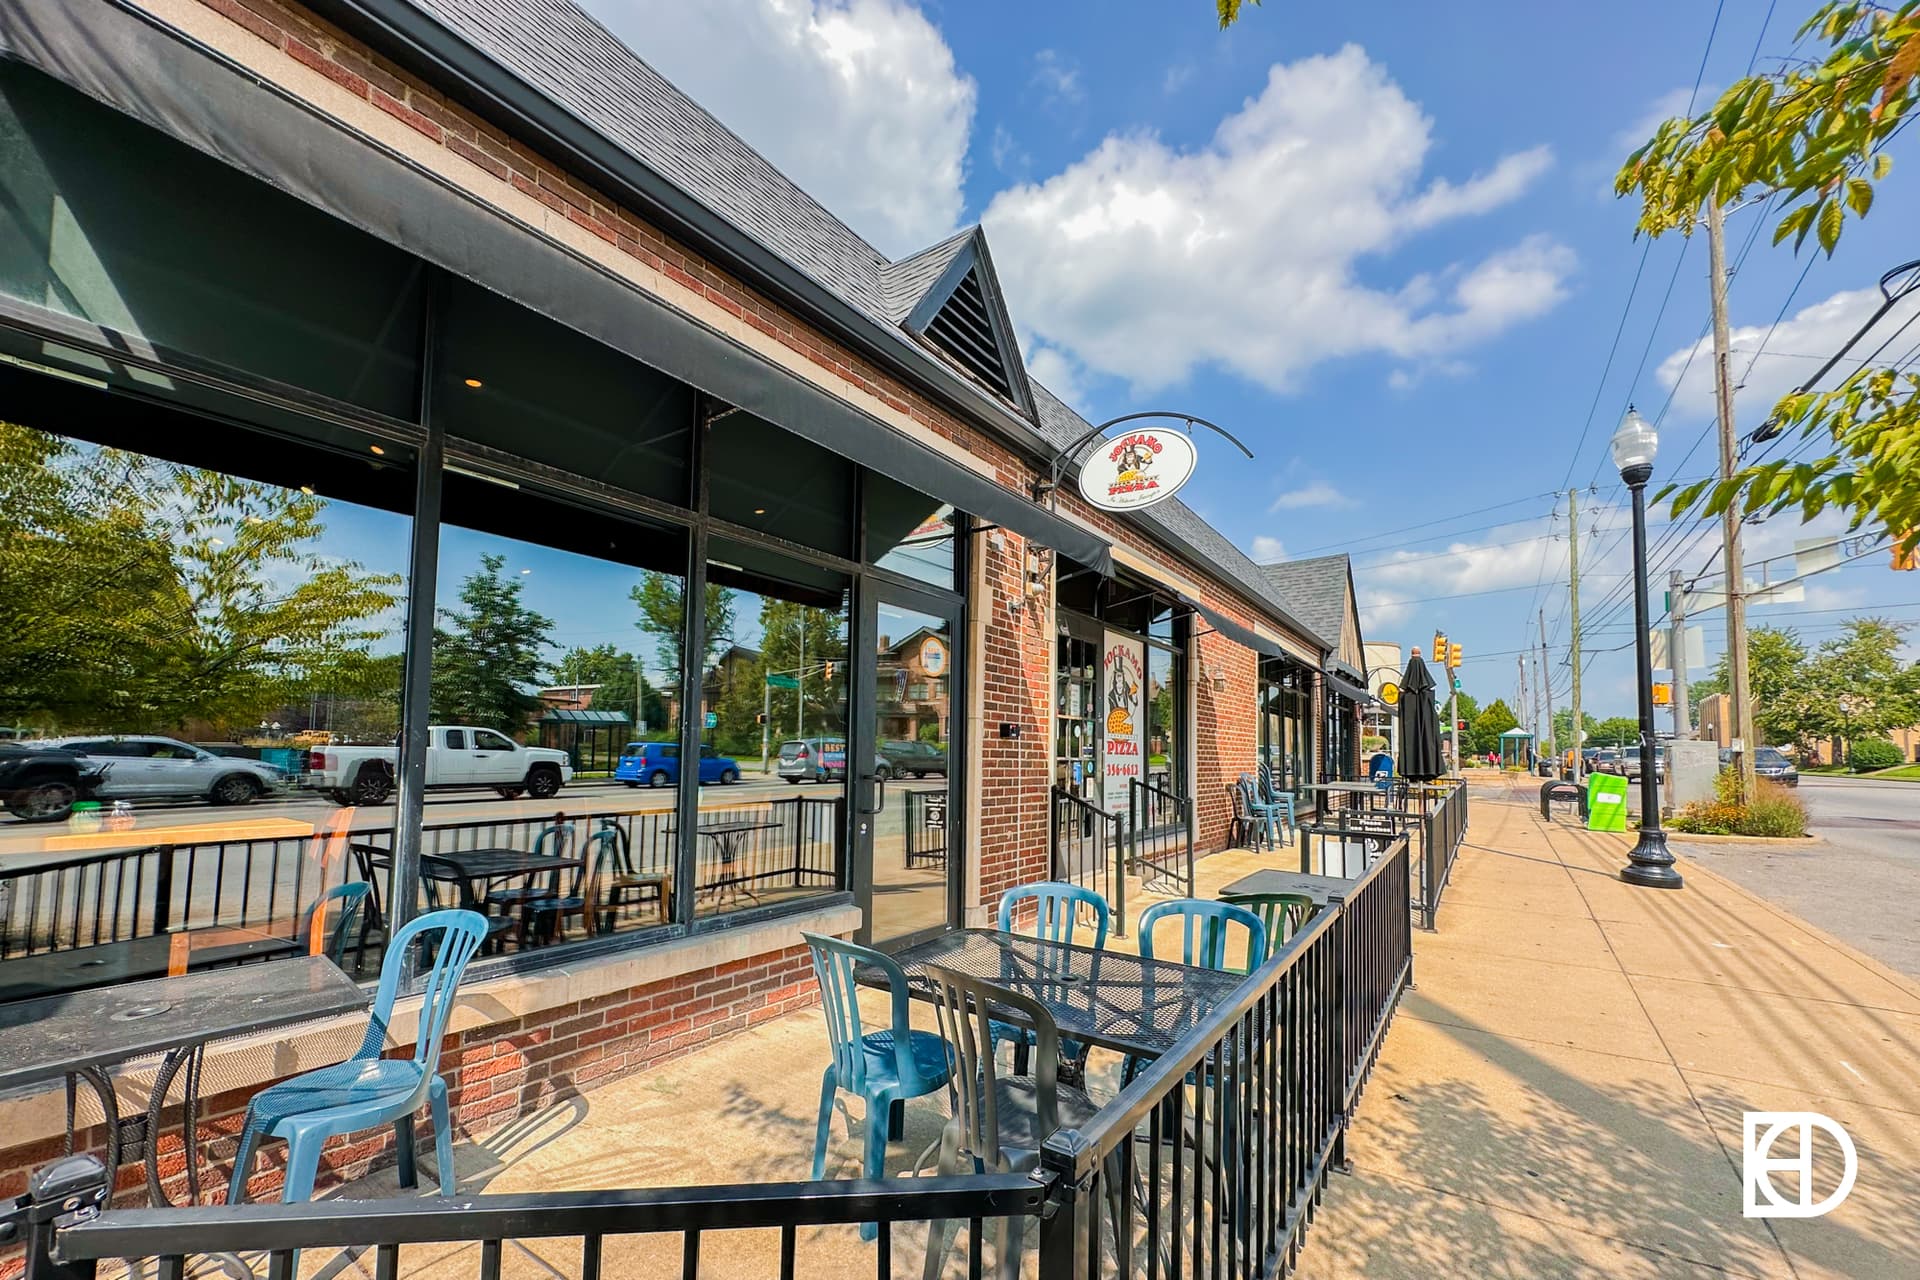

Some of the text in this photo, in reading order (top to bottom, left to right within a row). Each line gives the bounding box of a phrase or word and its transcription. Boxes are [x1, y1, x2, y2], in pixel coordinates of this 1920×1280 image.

[1109, 434, 1163, 462] JOCKAMO
[1108, 481, 1160, 496] PIZZA
[1103, 644, 1142, 680] JOCKAMO
[1107, 741, 1139, 756] PIZZA
